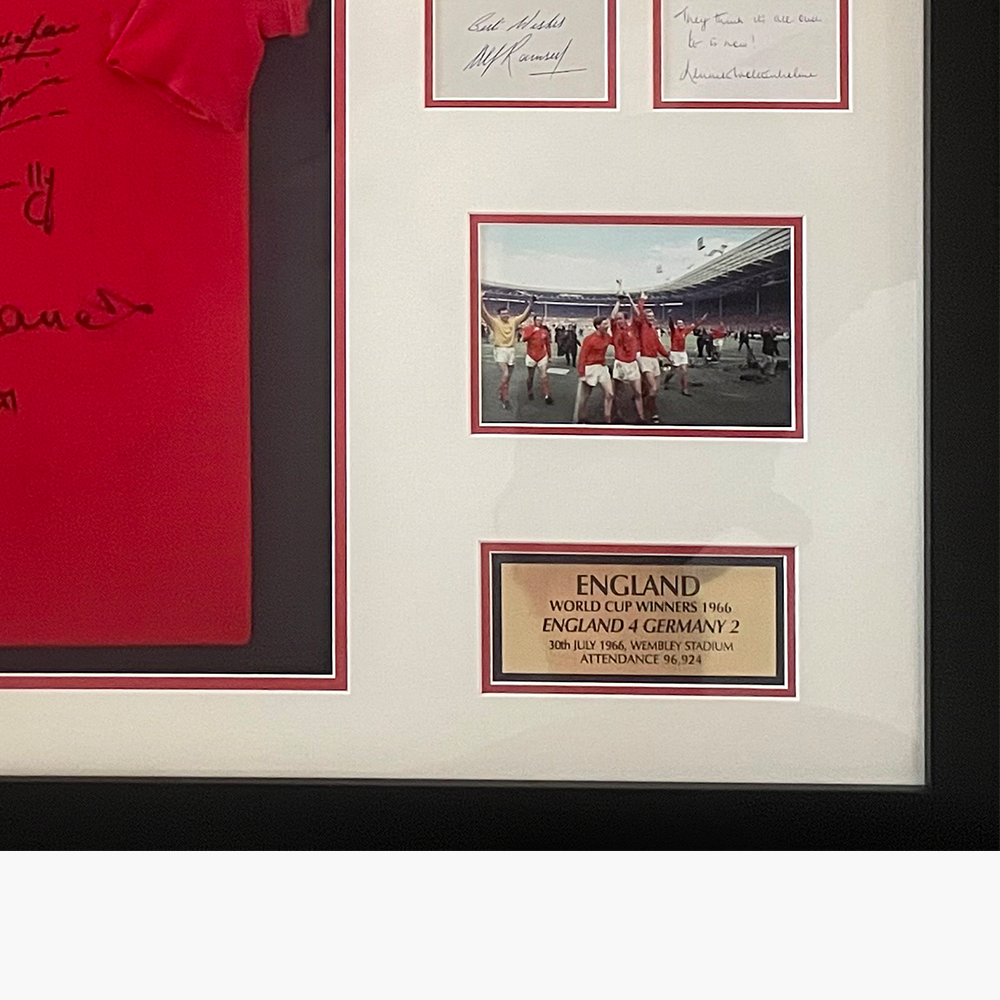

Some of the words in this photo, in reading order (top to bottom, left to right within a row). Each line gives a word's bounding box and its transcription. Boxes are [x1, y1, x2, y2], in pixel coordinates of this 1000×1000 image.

[576, 574, 701, 597] ENGLAND
[549, 600, 601, 612] WORLD
[604, 600, 632, 613] CUP
[635, 601, 698, 614] WINNERS
[702, 602, 732, 614] 1966
[542, 617, 625, 633] ENGLAND
[628, 618, 639, 633] 4
[642, 618, 727, 634] GERMANY
[729, 619, 740, 634] 2
[549, 640, 571, 650] 30th
[573, 640, 596, 651] JULY
[600, 640, 627, 652] 1966,
[630, 640, 682, 651] WEMBLEY
[684, 641, 734, 652] STADIUM
[580, 653, 661, 665] ATTENDANCE
[663, 654, 702, 666] 96,924
